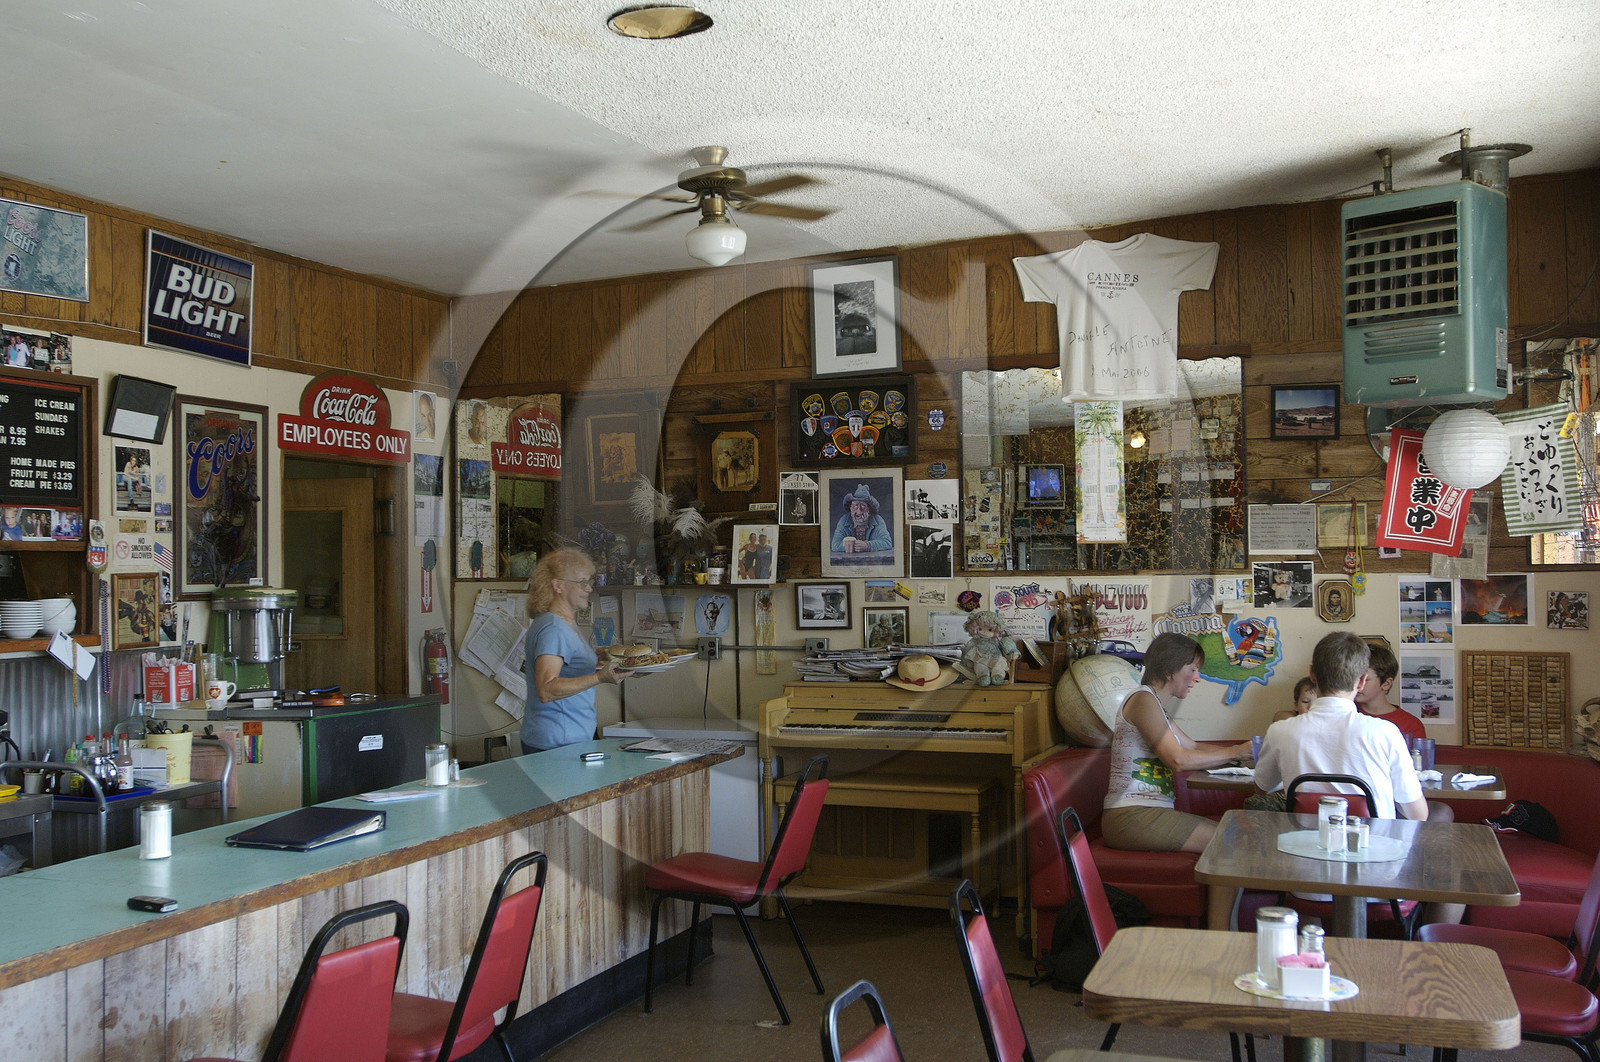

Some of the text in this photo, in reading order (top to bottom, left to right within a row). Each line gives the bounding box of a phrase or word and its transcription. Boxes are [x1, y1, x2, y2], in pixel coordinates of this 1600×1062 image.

[7, 206, 41, 243] Coors
[4, 225, 38, 256] LIGHT
[166, 263, 236, 305] BUD
[1087, 272, 1139, 283] CANNES
[153, 288, 245, 335] LIGHT
[205, 331, 221, 339] BEER
[1123, 366, 1149, 379] 2006
[331, 385, 352, 395] DRINK
[34, 398, 75, 411] ICE CREAM
[34, 412, 69, 424] SUNDAES
[9, 426, 27, 436] 8.95
[34, 425, 65, 437] SHAKES
[10, 437, 27, 446] 7.95
[282, 422, 407, 455] EMPLOYEES ONLY
[10, 457, 76, 470] HOME MADE PIES
[187, 427, 255, 501] Coors
[1537, 421, 1563, 516] ごゆっくり
[10, 469, 73, 481] FRUIT PIE $3.29
[1524, 435, 1548, 513] おくつろぎ
[9, 479, 73, 491] CREAM PIE $3.69
[131, 544, 152, 552] SMOKING
[1013, 584, 1040, 598] ROUTE
[1022, 593, 1039, 608] 66
[1071, 584, 1149, 613] RDEZVOUS
[1153, 615, 1223, 637] Corona
